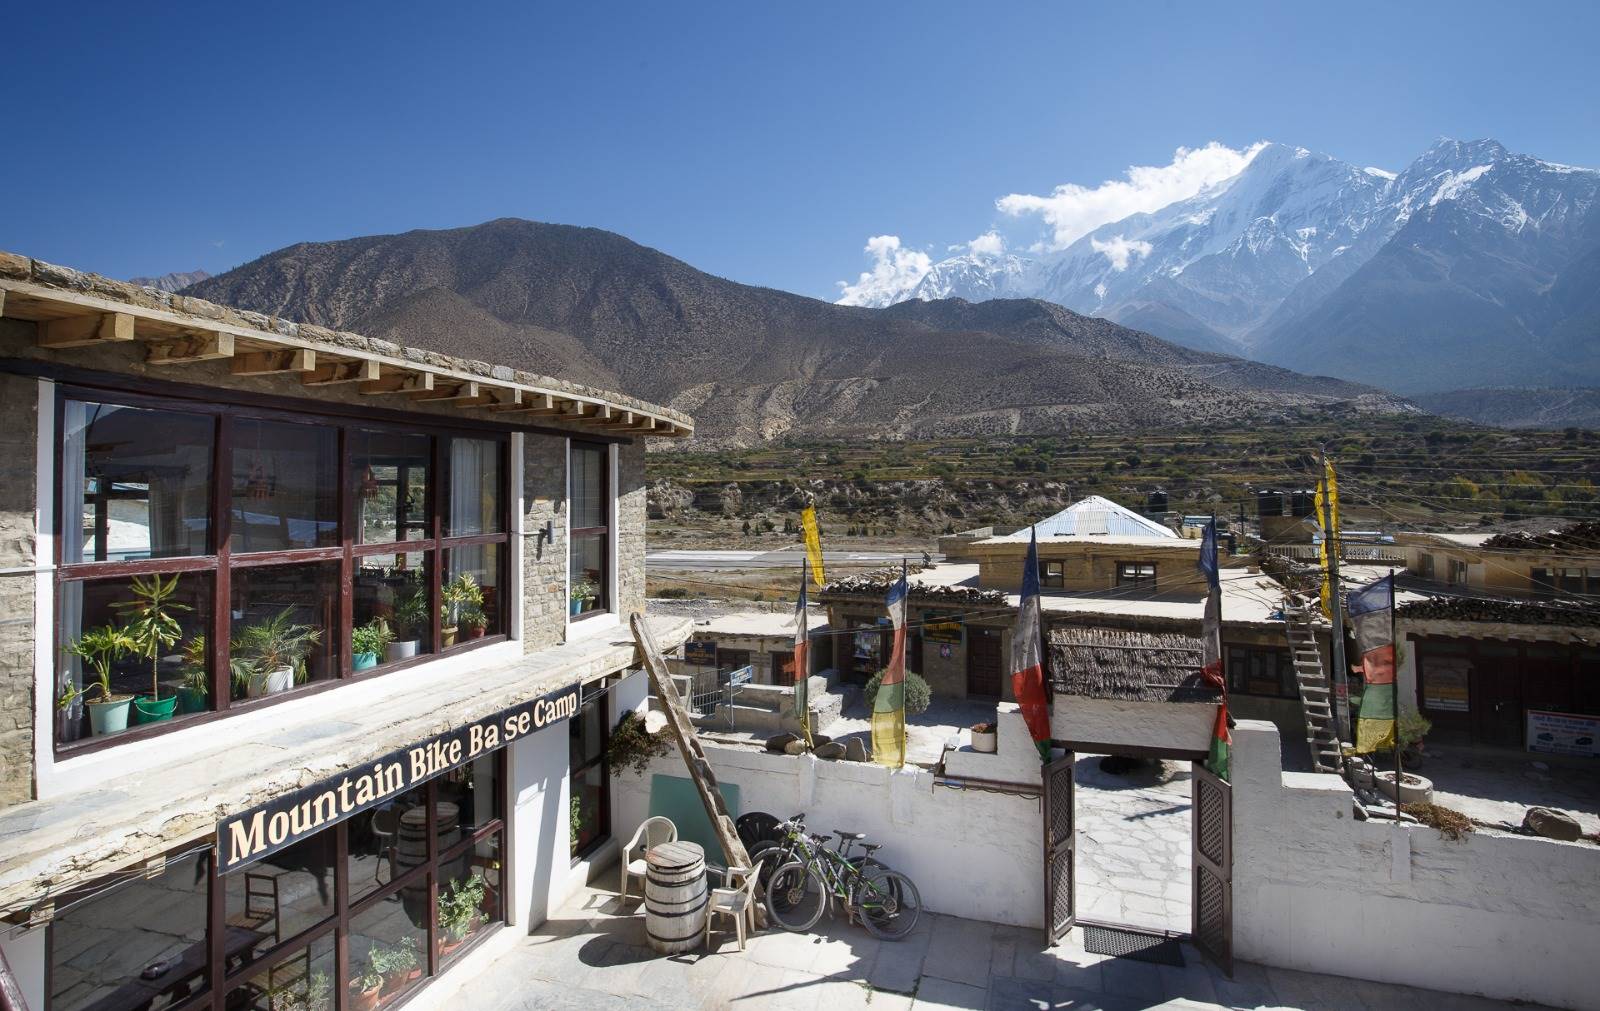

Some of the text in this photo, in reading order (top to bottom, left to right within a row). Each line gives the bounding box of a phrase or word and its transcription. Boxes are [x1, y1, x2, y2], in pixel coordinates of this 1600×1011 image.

[227, 761, 405, 866] Mountain
[409, 741, 462, 781] Bike
[534, 692, 577, 728] Camp
